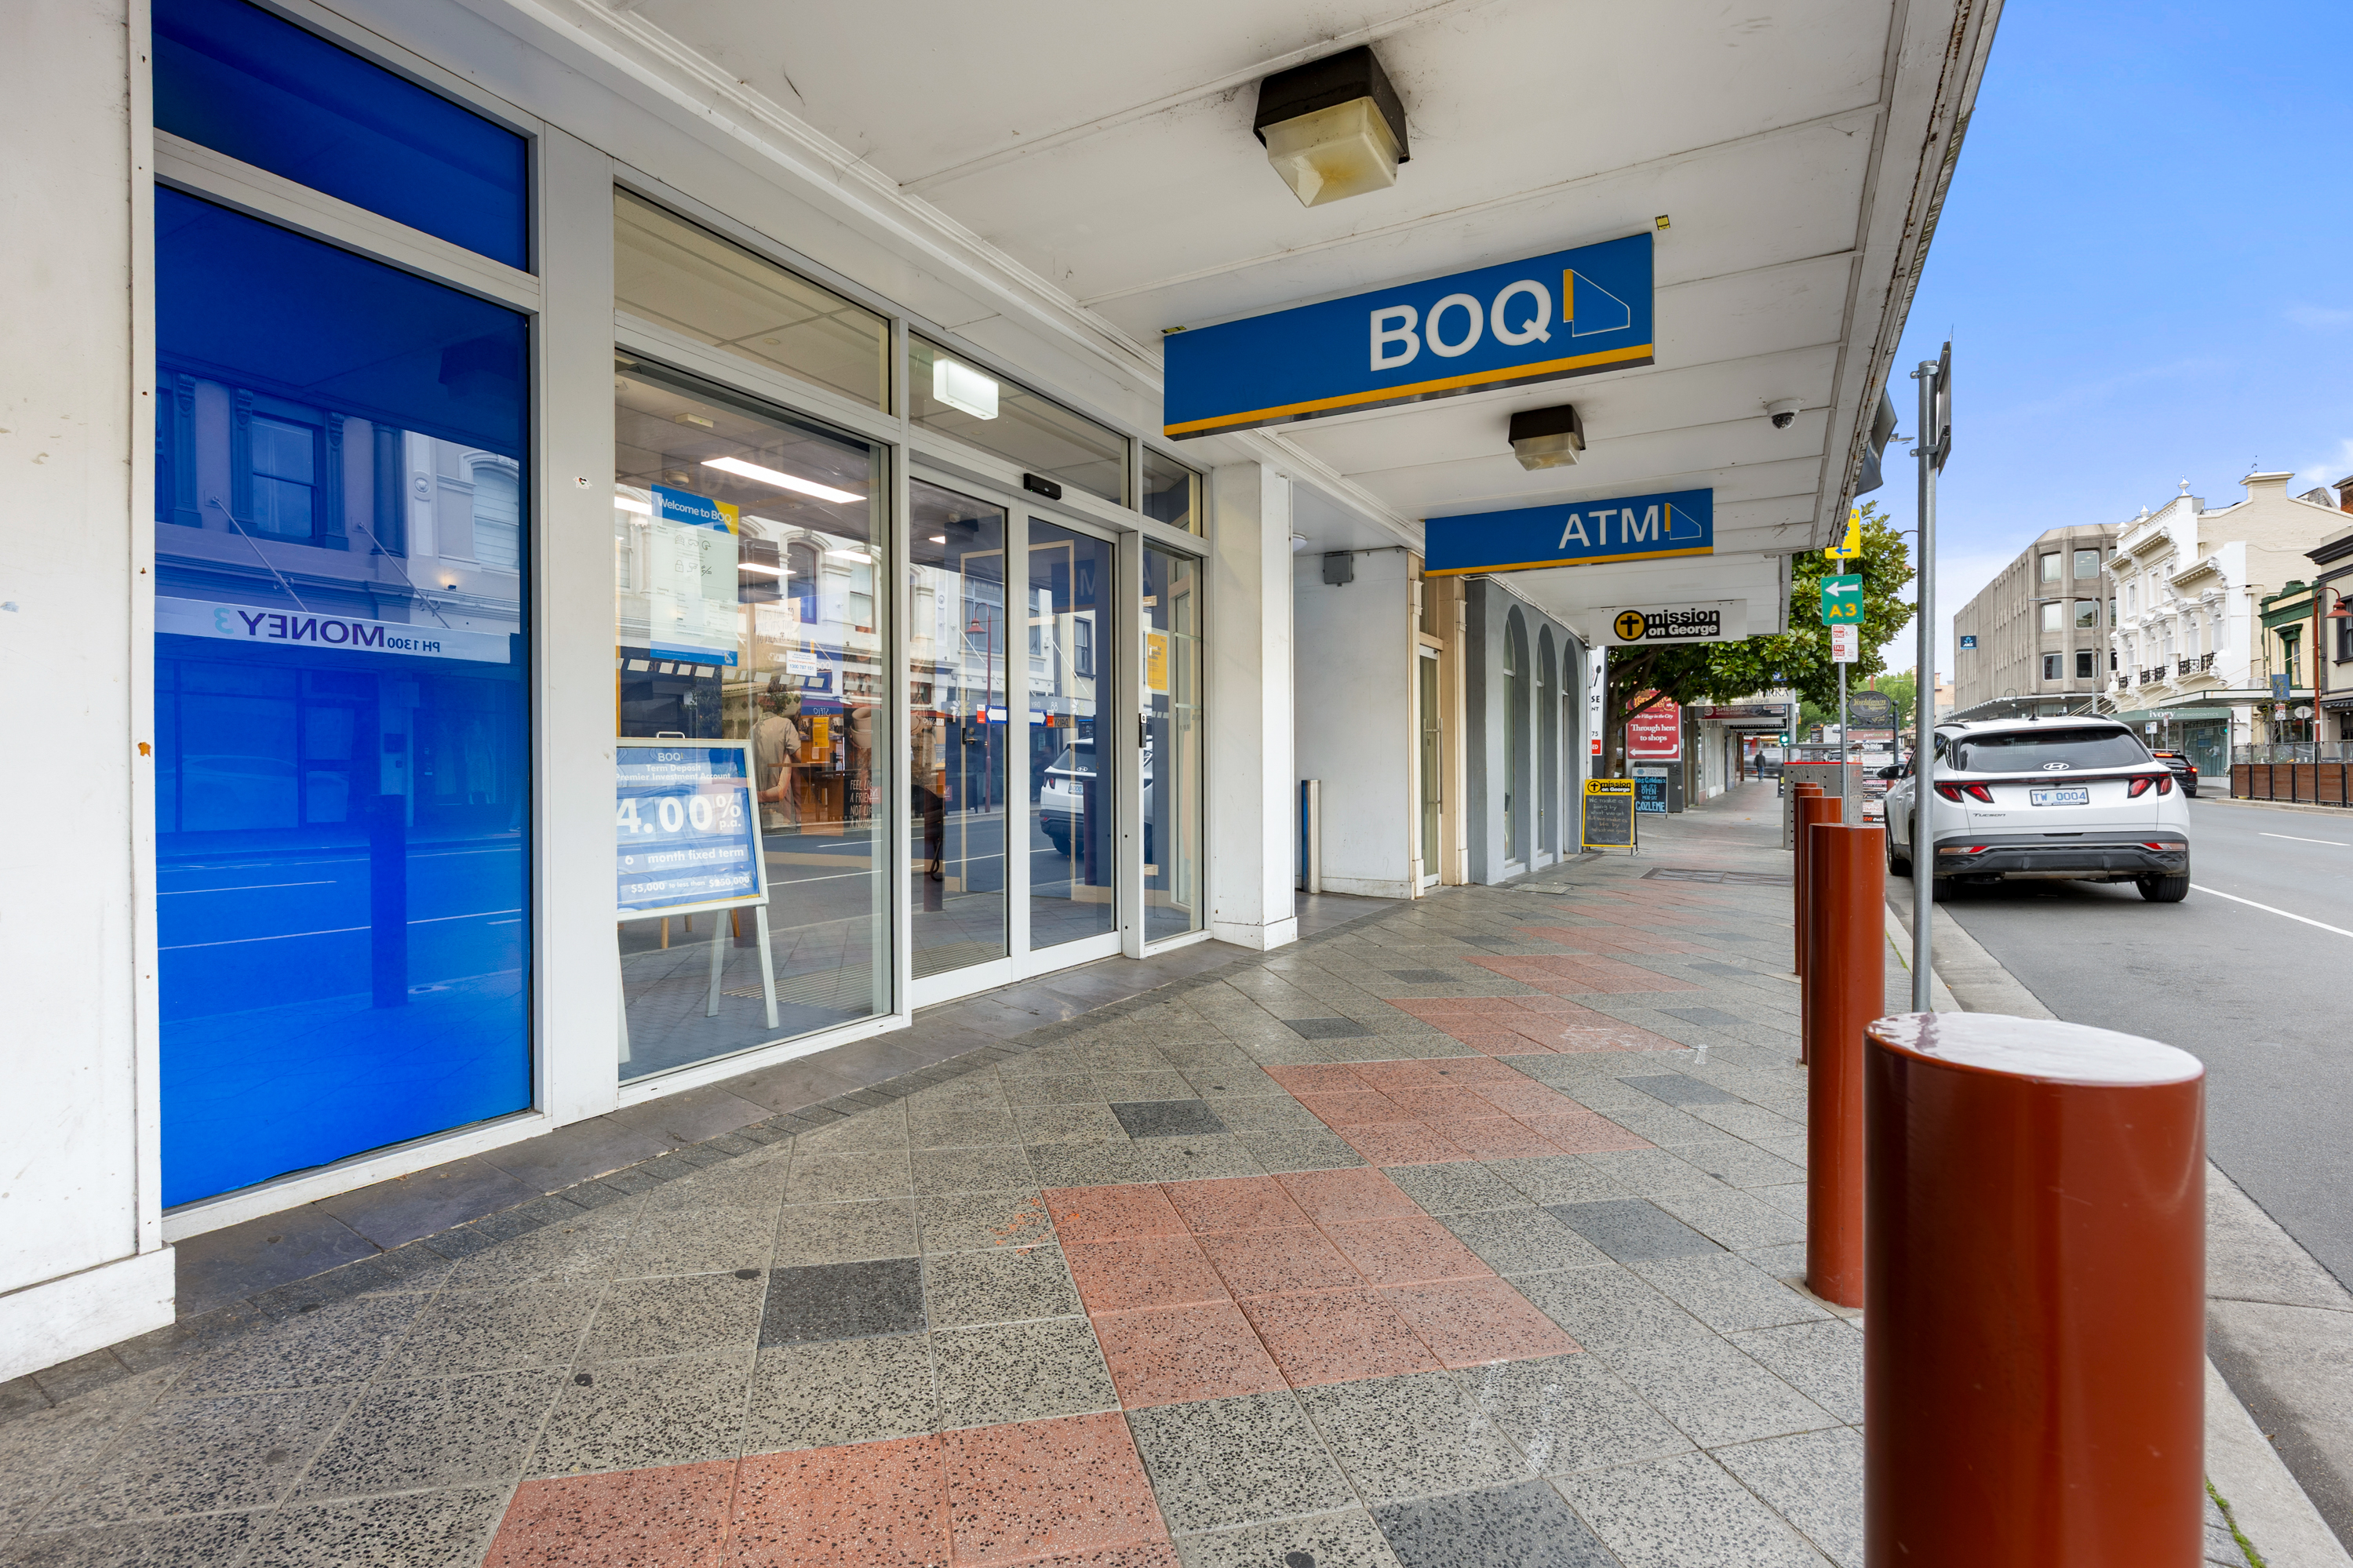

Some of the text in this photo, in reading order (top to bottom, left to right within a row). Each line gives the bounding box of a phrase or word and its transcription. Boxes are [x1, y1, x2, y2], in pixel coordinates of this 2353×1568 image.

[1370, 278, 1553, 372] BOQ
[657, 496, 732, 526] Welcome to BOQ
[1558, 504, 1659, 549] ATM
[1645, 607, 1721, 625] mission
[1648, 624, 1717, 636] on George
[1630, 724, 1660, 733] Through
[1648, 734, 1668, 743] shops
[657, 752, 681, 762] BOQ
[670, 764, 701, 773] Deposit
[850, 780, 862, 791] FEEL
[850, 792, 872, 803] A FRIEN
[2033, 791, 2086, 802] TW 0004
[850, 805, 861, 816] NOT
[719, 820, 741, 829] p.a.
[625, 848, 745, 865] 6 month fixed term
[631, 882, 665, 894] $5,000
[690, 879, 705, 887] than
[708, 875, 750, 888] $250,000
